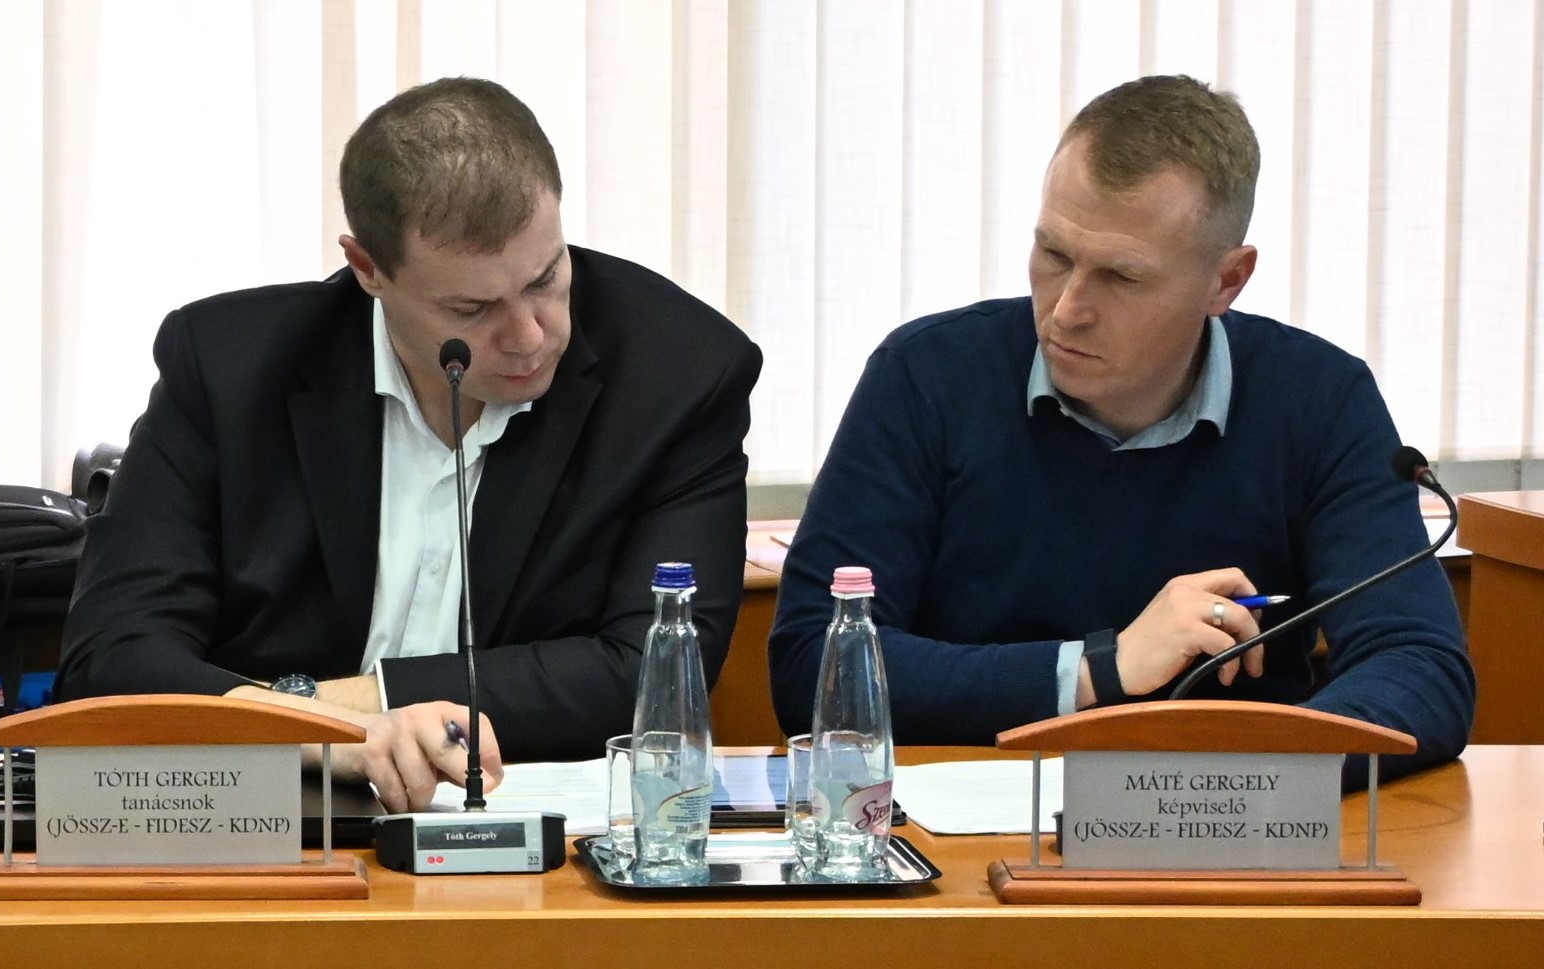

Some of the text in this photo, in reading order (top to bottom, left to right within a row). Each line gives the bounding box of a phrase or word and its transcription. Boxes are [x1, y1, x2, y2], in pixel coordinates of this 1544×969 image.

[93, 767, 242, 788] TÓTH GERGELY
[1124, 770, 1280, 791] MÁTÉ GERGELY
[120, 793, 216, 811] tanácsnok
[1157, 797, 1247, 819] képviselő
[46, 814, 129, 839] (JÖSSZ-E
[145, 817, 213, 834] FIDESZ
[229, 816, 291, 835] KDNP)
[444, 831, 498, 841] Tóth Gergely
[1074, 817, 1160, 843] (JÖSSZ-E
[1177, 821, 1247, 839] FIDESZ
[1265, 821, 1329, 840] KDNP)
[527, 856, 540, 866] 22
